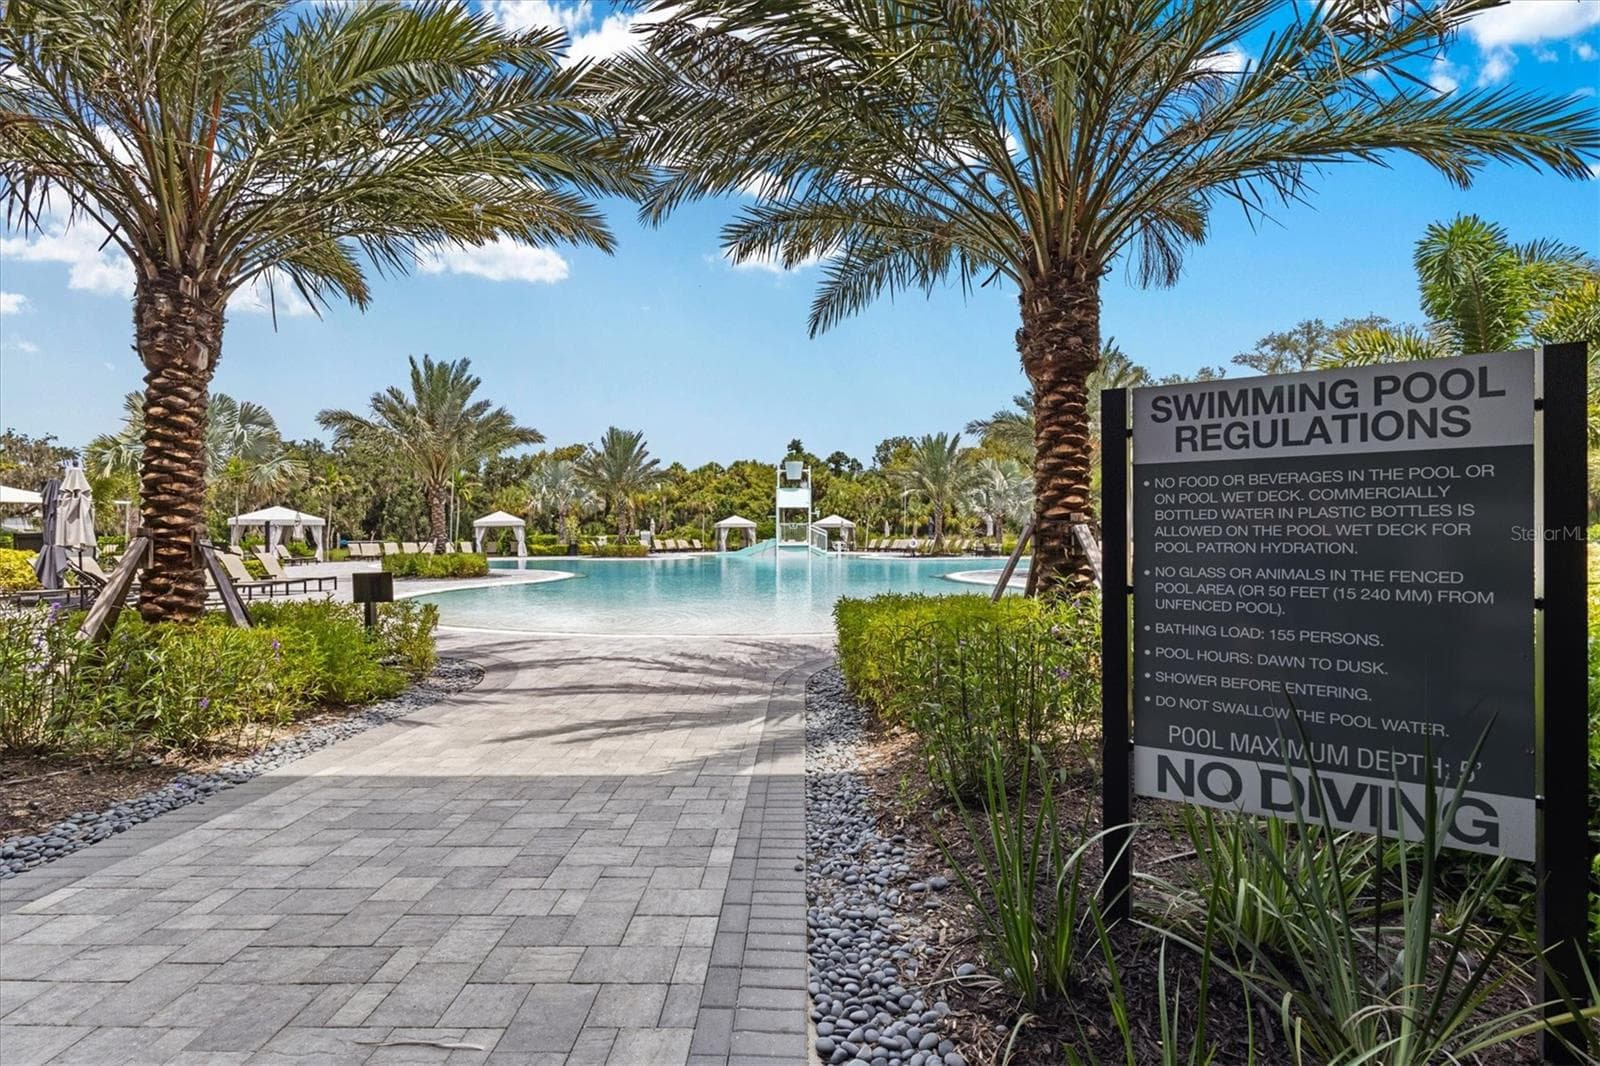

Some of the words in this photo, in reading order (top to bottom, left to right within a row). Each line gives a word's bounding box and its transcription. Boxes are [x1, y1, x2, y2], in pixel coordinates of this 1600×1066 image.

[1151, 379, 1358, 423] SWIMMING
[1374, 366, 1505, 406] POOL
[1175, 405, 1471, 452] REGULATIONS
[1155, 477, 1175, 488] NO
[1179, 475, 1219, 488] FOOD
[1223, 474, 1245, 486] OR
[1249, 470, 1343, 485] BEVERAGES
[1349, 469, 1364, 482] IN
[1368, 468, 1404, 481] THE
[1409, 466, 1460, 479] POOL
[1466, 464, 1495, 478] OR
[1155, 493, 1175, 505] ON
[1179, 492, 1218, 504] POOL
[1222, 491, 1253, 502] WET
[1258, 490, 1304, 502] DECK.
[1309, 485, 1450, 501] COMMERCIALLY
[1155, 509, 1217, 520] BOTTLED
[1221, 508, 1274, 519] WATER
[1278, 508, 1293, 519] IN
[1298, 505, 1365, 519] PLASTIC
[1371, 504, 1452, 517] BOTTLES
[1458, 504, 1475, 516] IS
[1155, 525, 1222, 536] ALLOWED
[1226, 525, 1248, 536] ON
[1252, 525, 1282, 536] THE
[1287, 524, 1331, 536] POOL
[1335, 524, 1372, 536] WET
[1377, 524, 1427, 536] DECK
[1432, 523, 1471, 536] FOR
[1155, 542, 1193, 553] POOL
[1197, 542, 1256, 553] PATRON
[1261, 542, 1358, 554] HYDRATION.
[1155, 567, 1175, 578] NO
[1179, 567, 1226, 578] GLASS
[1230, 568, 1251, 579] OR
[1255, 568, 1325, 580] ANIMALS
[1330, 569, 1346, 581] IN
[1350, 570, 1384, 582] THE
[1390, 570, 1463, 584] FENCED
[1155, 583, 1193, 594] POOL
[1196, 584, 1235, 595] AREA
[1238, 584, 1264, 597] (OR
[1268, 586, 1286, 597] 50
[1290, 586, 1329, 599] FEET
[1333, 587, 1356, 602] (15
[1361, 588, 1390, 601] 240
[1396, 589, 1432, 605] MM)
[1438, 590, 1494, 604] FROM
[1155, 599, 1232, 612] UNFENCED
[1236, 602, 1285, 616] POOL).
[1156, 623, 1217, 637] BATHING
[1220, 626, 1264, 639] LOAD:
[1270, 629, 1295, 641] 155
[1300, 630, 1384, 647] PERSONS.
[1156, 647, 1194, 660] POOL
[1197, 649, 1252, 664] HOURS:
[1257, 654, 1305, 668] DAWN
[1309, 657, 1332, 671] TO
[1337, 660, 1388, 675] DUSK.
[1155, 671, 1217, 687] SHOWER
[1221, 677, 1281, 693] BEFORE
[1285, 682, 1372, 701] ENTERING.
[1156, 695, 1176, 707] DO
[1180, 697, 1209, 710] NOT
[1212, 701, 1290, 720] SWALLOW
[1296, 709, 1325, 724] THE
[1330, 713, 1377, 729] POOL
[1381, 718, 1449, 737] WATER.
[1169, 725, 1224, 750] POOL
[1230, 732, 1348, 766] MAXMUM
[1358, 747, 1450, 780] DEPTH:
[1158, 754, 1243, 803] NO
[1259, 768, 1499, 848] DIVING
